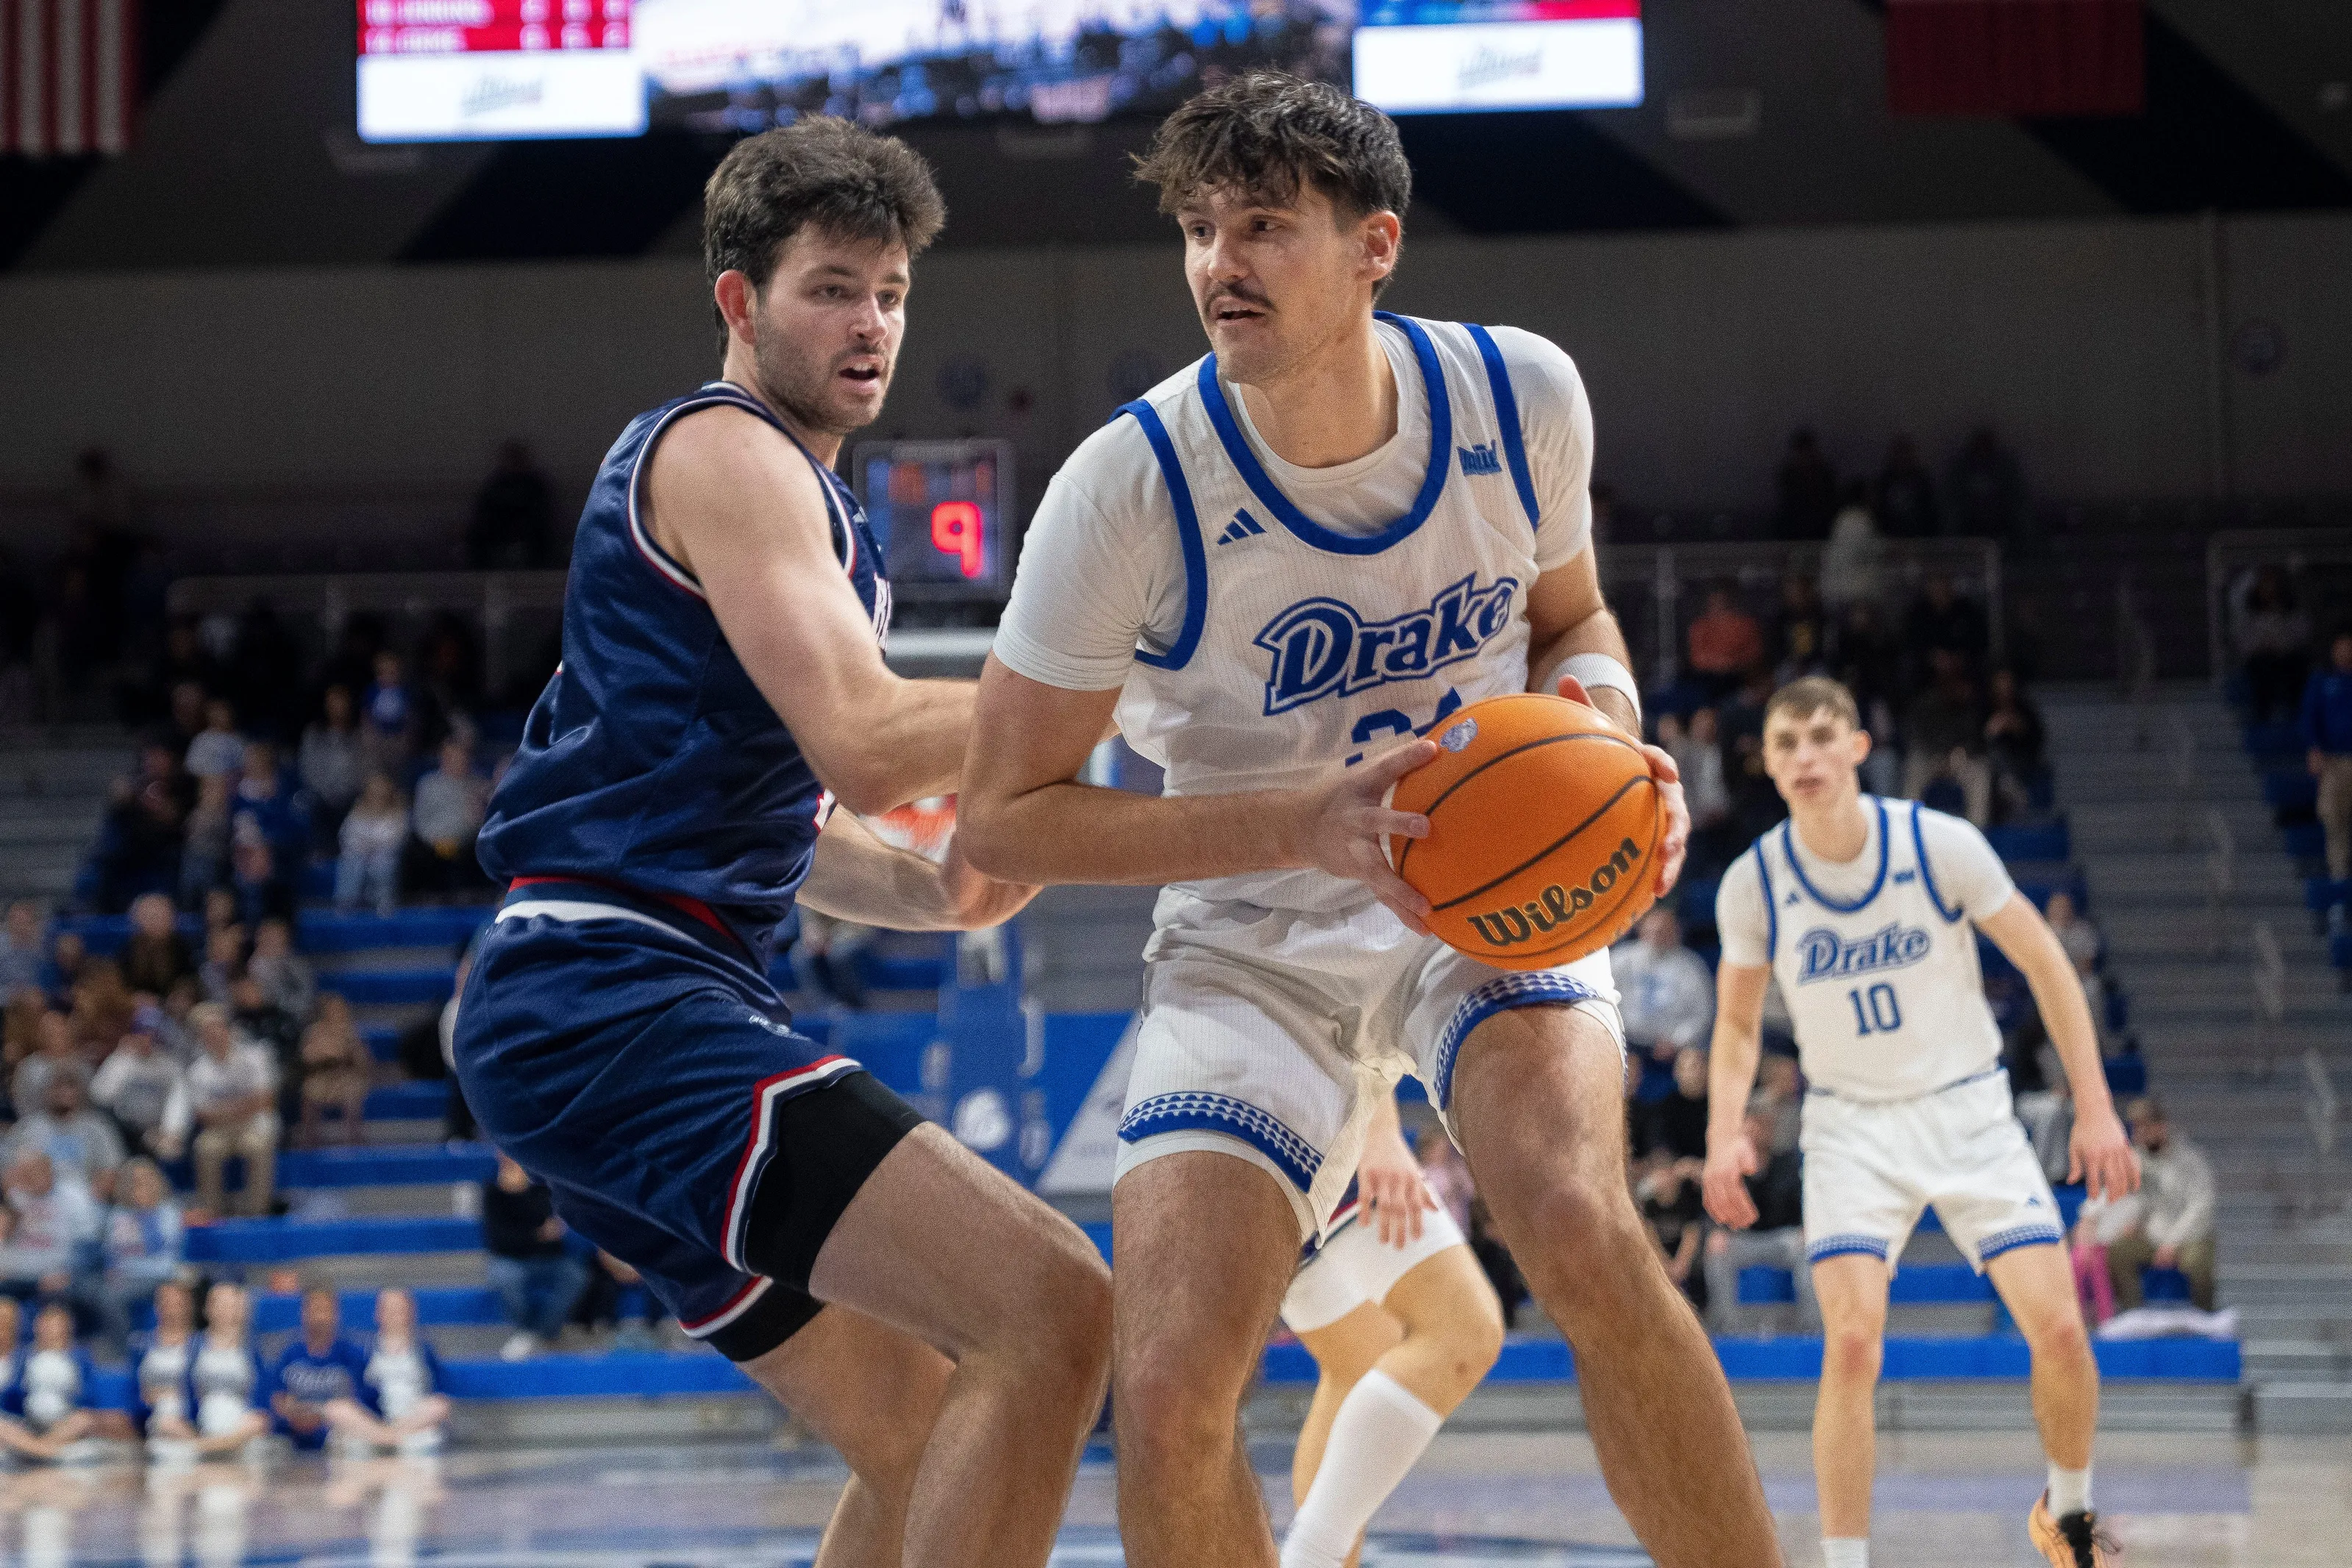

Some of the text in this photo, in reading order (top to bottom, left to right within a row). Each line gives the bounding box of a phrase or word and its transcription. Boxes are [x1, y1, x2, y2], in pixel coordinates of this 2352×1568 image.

[931, 501, 983, 579] 9
[1253, 571, 1519, 716] Drake
[1467, 836, 1642, 947] Wilson
[1796, 921, 1931, 986] Drake
[1848, 982, 1903, 1036] 10
